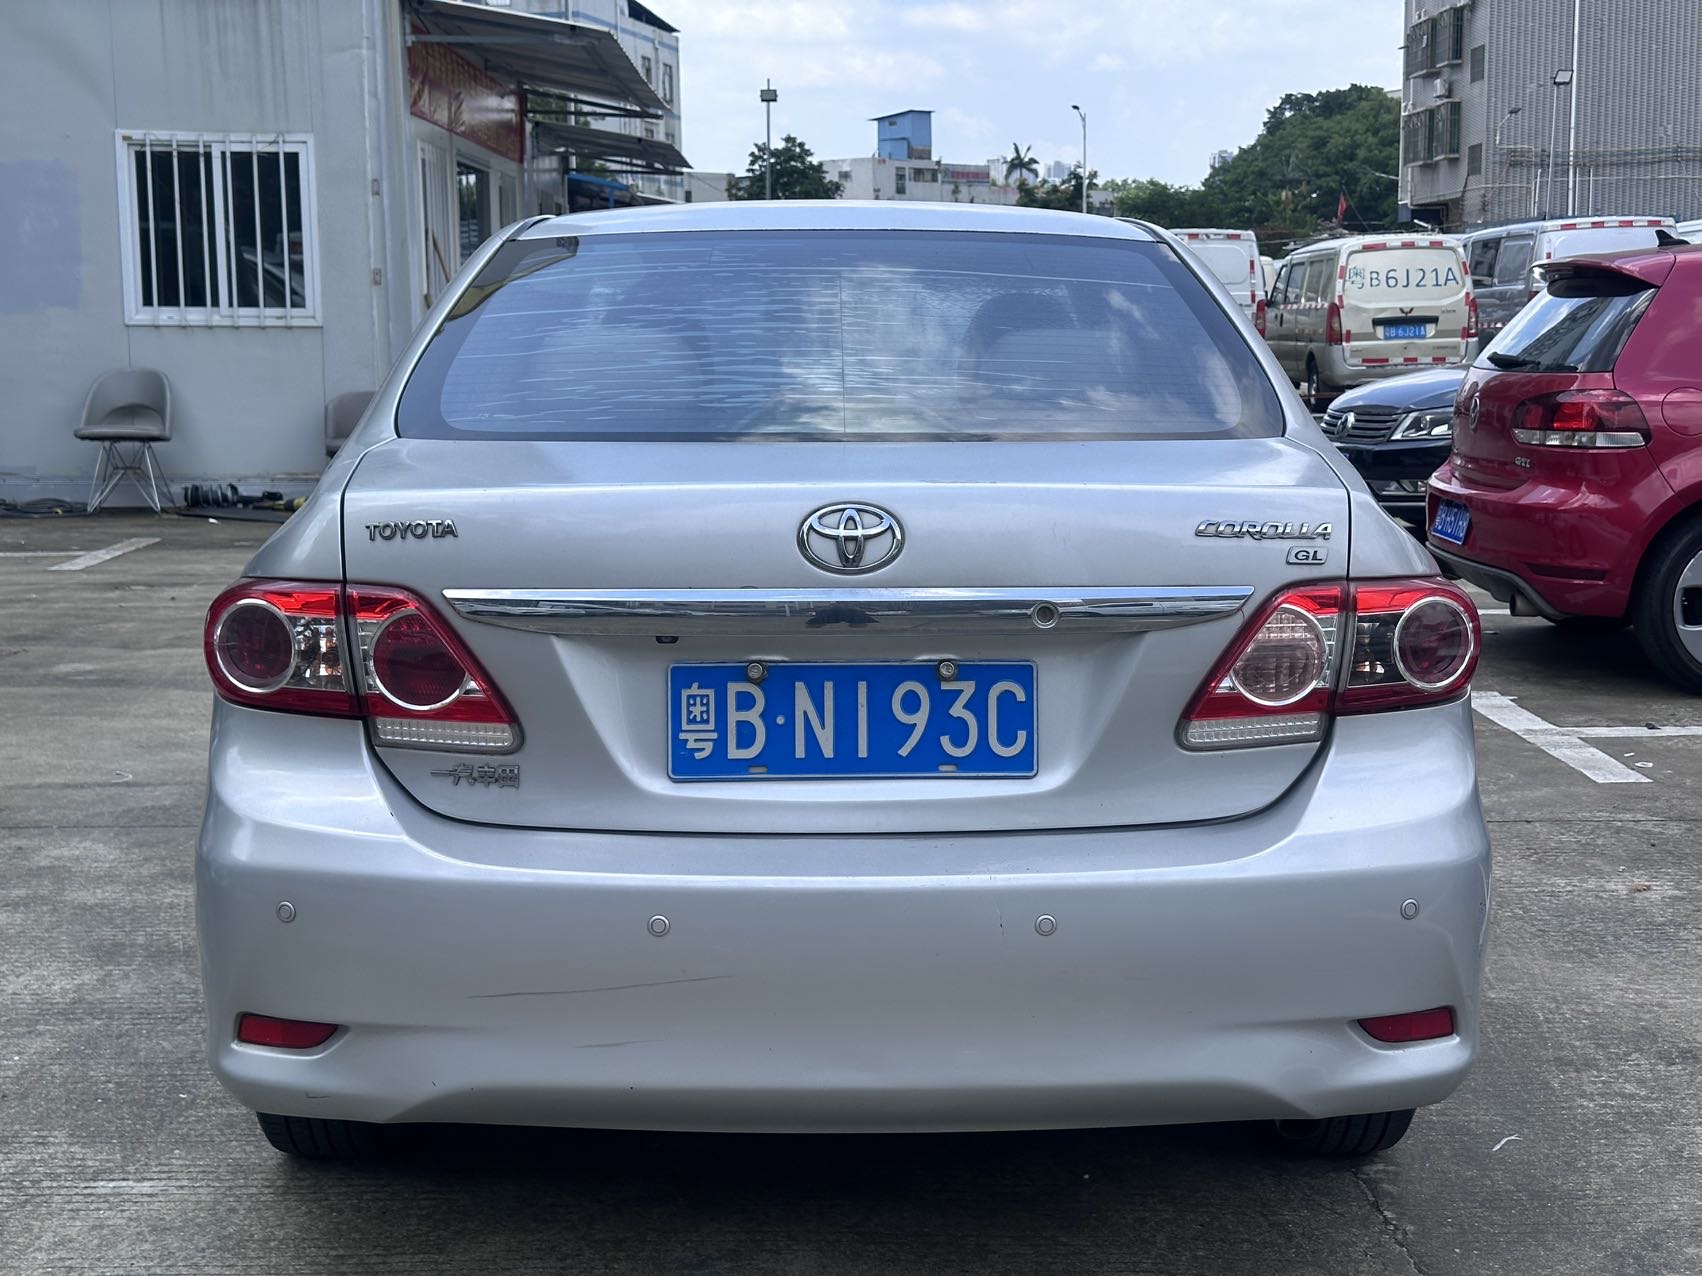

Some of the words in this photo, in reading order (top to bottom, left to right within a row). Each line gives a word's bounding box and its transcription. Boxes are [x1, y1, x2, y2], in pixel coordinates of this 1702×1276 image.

[1349, 266, 1459, 290] 粤B6J21A
[365, 519, 459, 541] TOYOTA
[1195, 519, 1332, 540] COROLLA
[1294, 549, 1323, 561] GL
